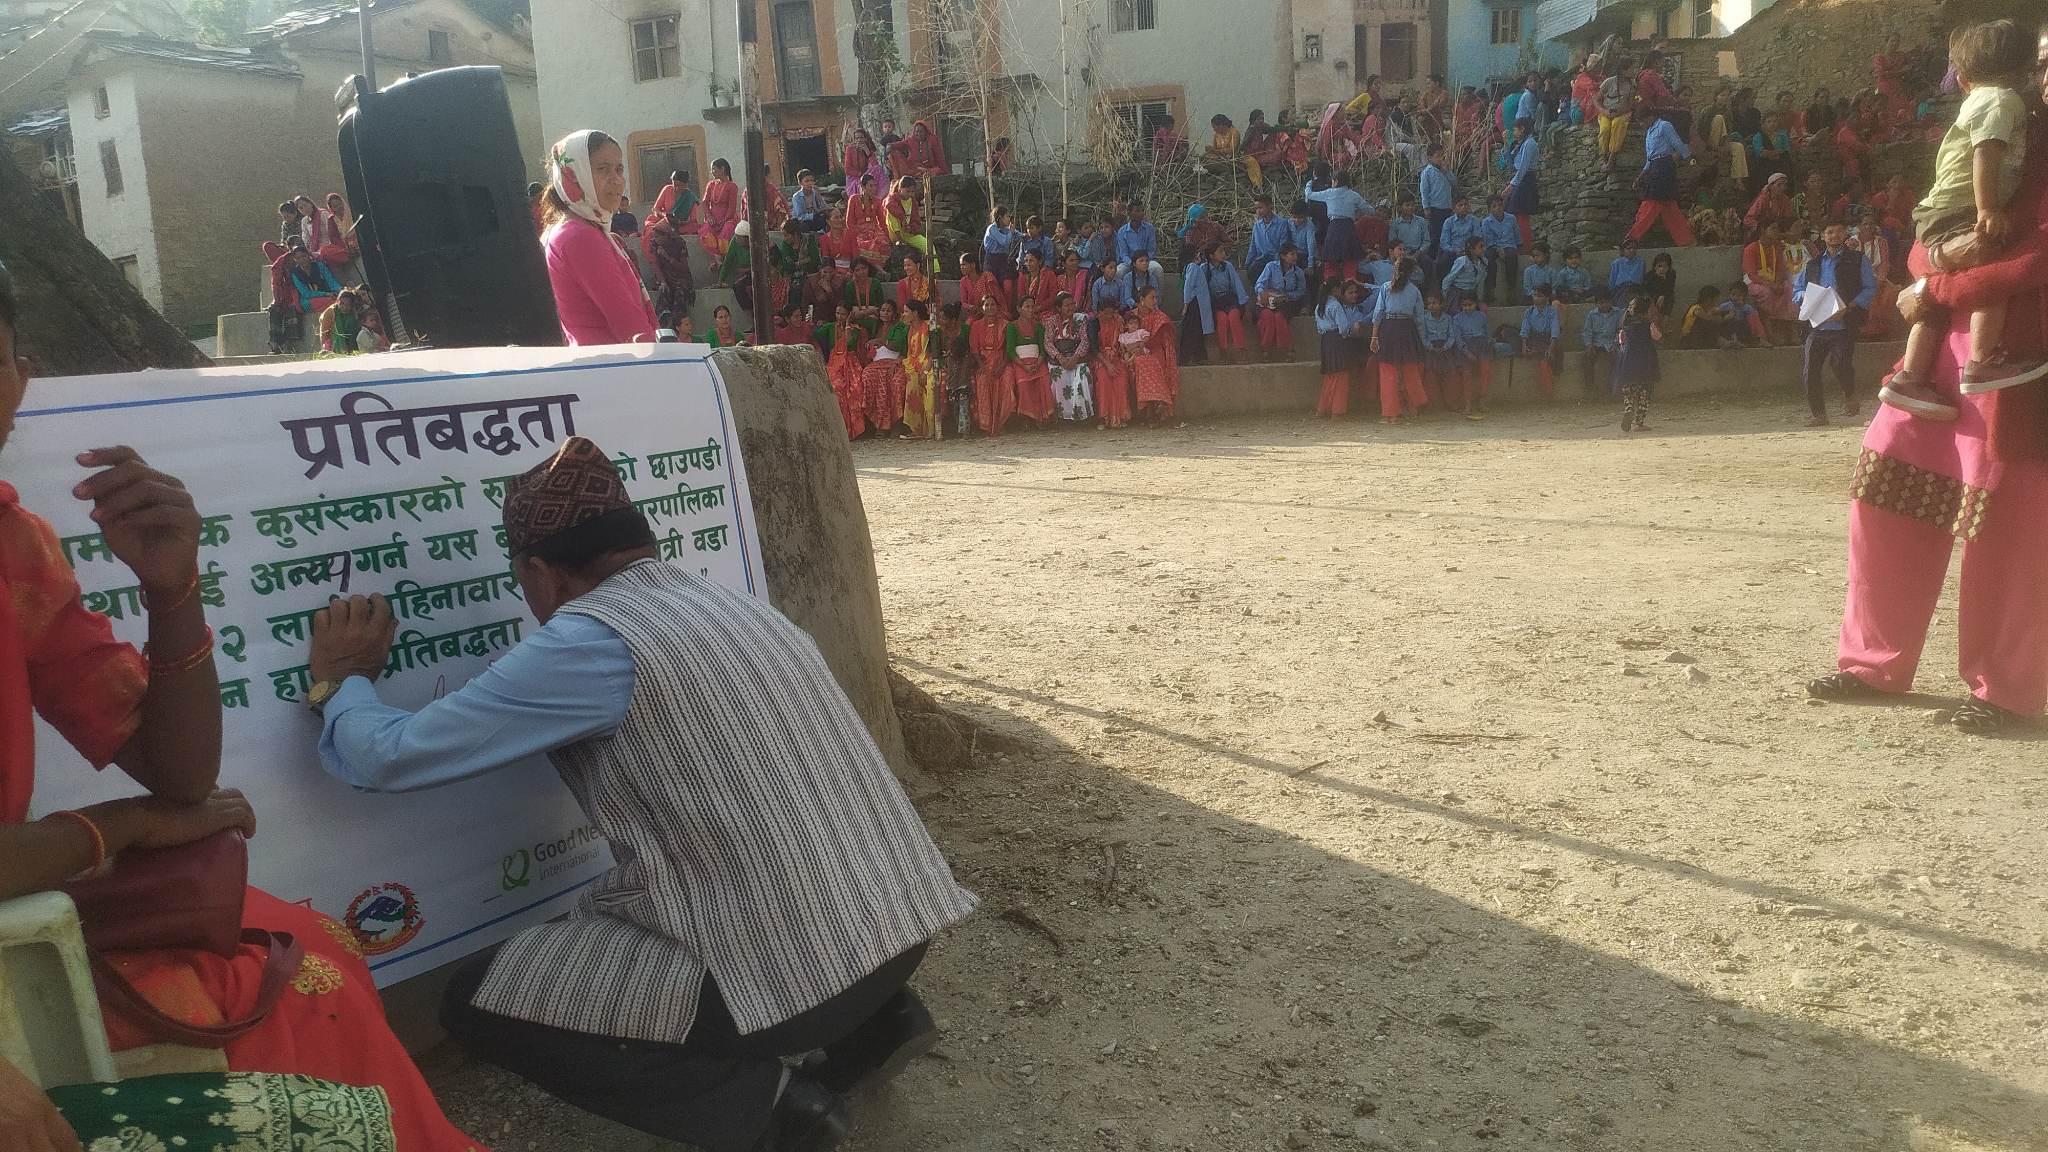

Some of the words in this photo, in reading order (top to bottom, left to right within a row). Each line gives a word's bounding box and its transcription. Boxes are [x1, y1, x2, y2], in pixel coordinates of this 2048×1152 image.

[280, 391, 580, 480] प्रतिबद्धता
[251, 475, 466, 549] कुसंस्कारको
[647, 437, 721, 480] छाउपडी
[219, 625, 247, 662] २
[692, 524, 728, 552] वडा
[351, 531, 409, 573] गर्न
[423, 529, 478, 561] यस
[534, 829, 577, 862] Good
